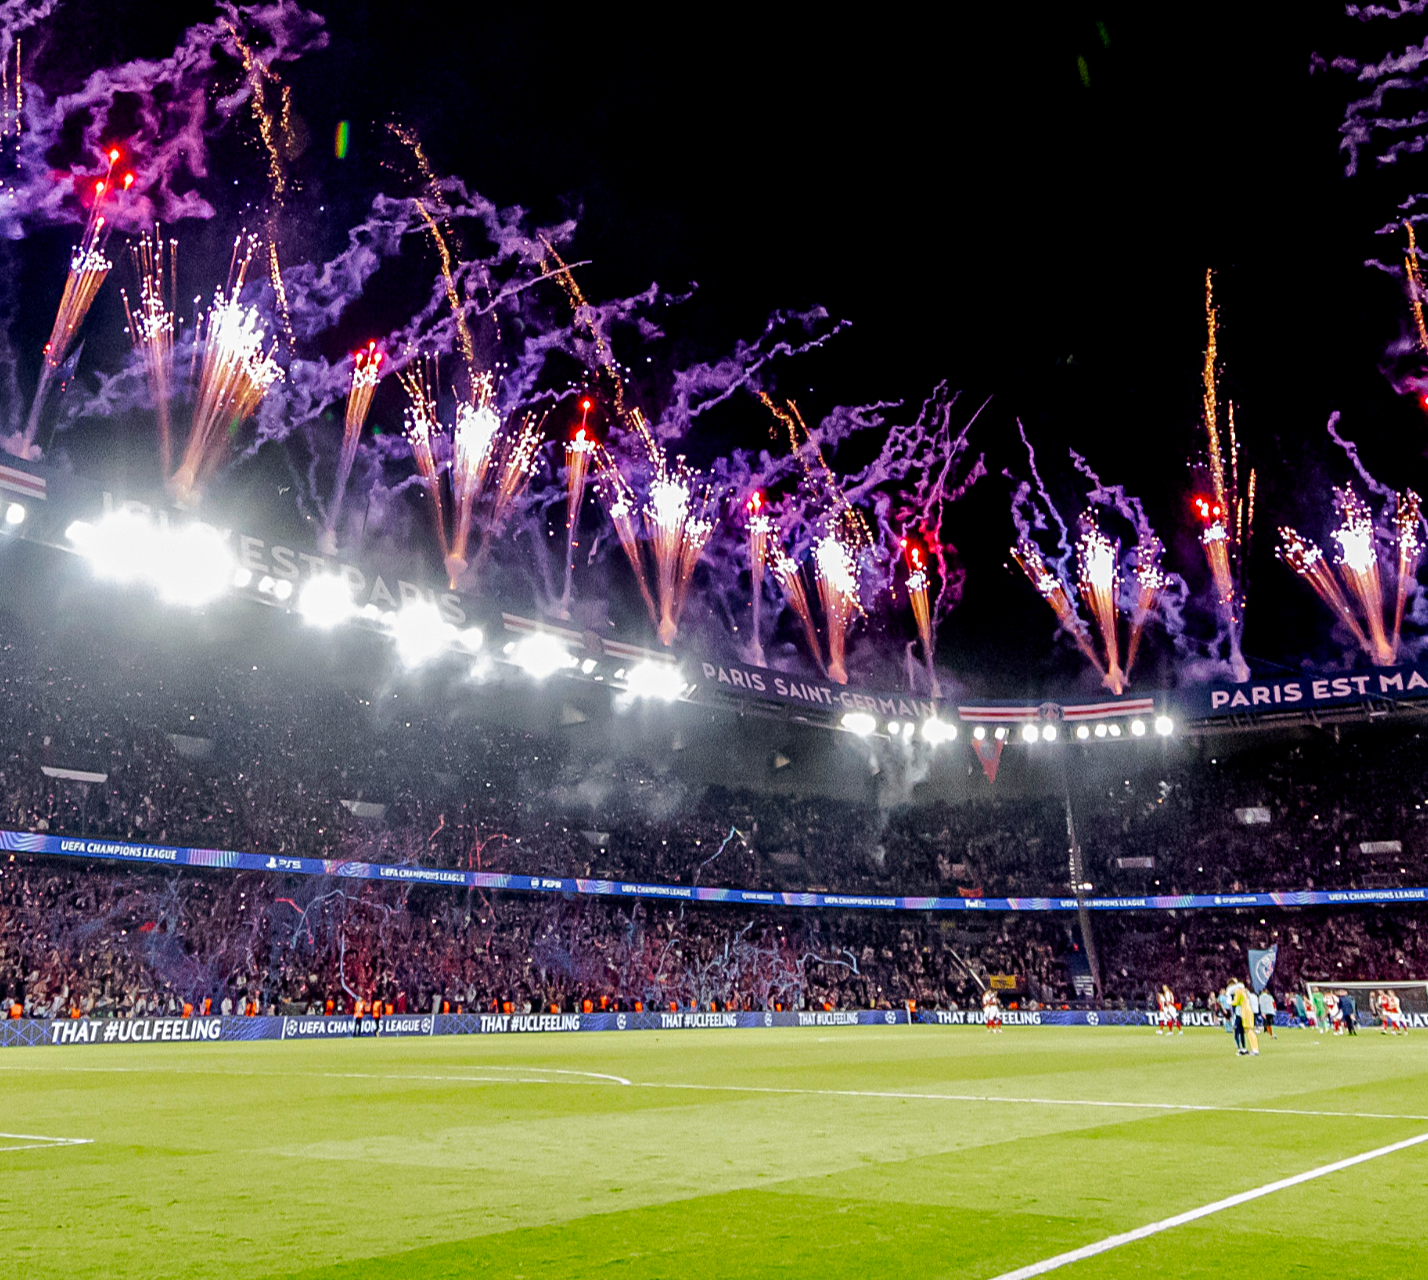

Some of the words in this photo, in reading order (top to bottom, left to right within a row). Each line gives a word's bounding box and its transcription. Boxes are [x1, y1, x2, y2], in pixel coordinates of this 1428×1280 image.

[702, 662, 767, 692] PARIS
[774, 677, 936, 717] SAINT-GERMAIN
[1212, 681, 1303, 710] PARIS
[1313, 675, 1370, 700] EST
[60, 840, 85, 852] UEFA
[87, 843, 141, 857] CHAMPIONS
[142, 848, 177, 860] LEAGUE
[279, 859, 302, 869] PS5
[380, 868, 398, 877] UEFA
[399, 869, 439, 881] CHAMPIONS
[439, 873, 466, 883] LEAGUE
[621, 885, 636, 893] UEFA
[637, 886, 669, 895] CHAMPIONS
[670, 889, 691, 897] LEAGUE
[1328, 893, 1348, 901] UEFA
[1348, 891, 1394, 900] CHAMPIONS
[1394, 889, 1425, 899] LEAGUE
[839, 897, 873, 905] CHAMPIONS
[873, 899, 896, 907] LEAGUE
[481, 1016, 511, 1032] THAT
[511, 1015, 579, 1032] #UCLFEELING
[661, 1013, 684, 1028] THAT
[685, 1013, 736, 1028] #UCLFEELING
[798, 1013, 816, 1026] THAT
[817, 1012, 858, 1025] #UCLFEELING
[936, 1011, 965, 1024] THAT
[967, 1011, 1041, 1024] #UCFEELING
[51, 1021, 102, 1043] THAT
[103, 1019, 221, 1042] #UCLFEELING
[299, 1021, 325, 1034] UEFA
[327, 1020, 383, 1034] CHAMIONS
[385, 1020, 419, 1032] LEAGUE
